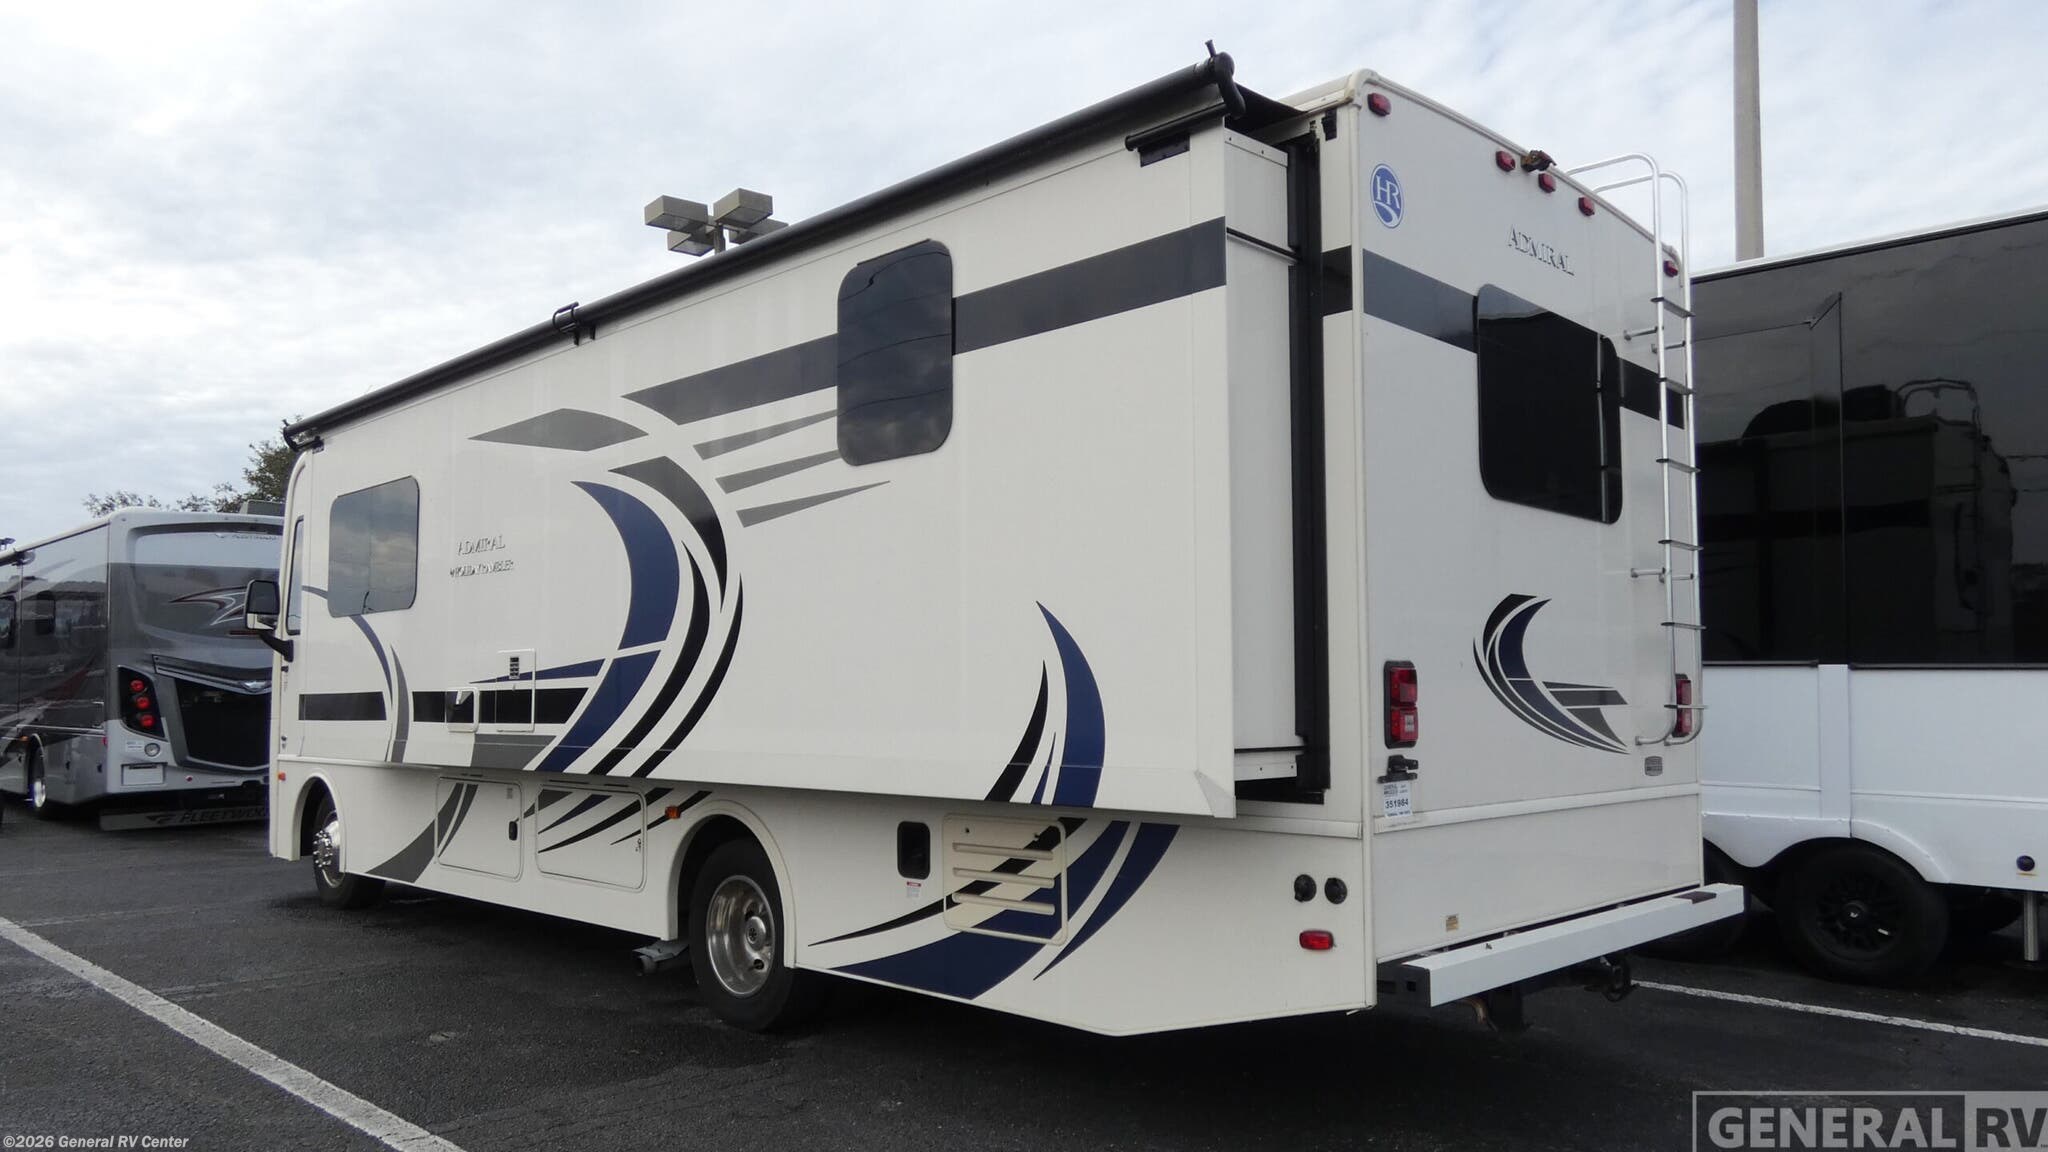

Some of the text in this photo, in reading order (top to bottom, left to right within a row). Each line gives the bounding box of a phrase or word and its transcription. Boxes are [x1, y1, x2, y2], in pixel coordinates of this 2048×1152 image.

[1376, 174, 1400, 209] HR
[1507, 226, 1575, 276] ADMIRAL
[458, 535, 505, 555] ADMIRAL
